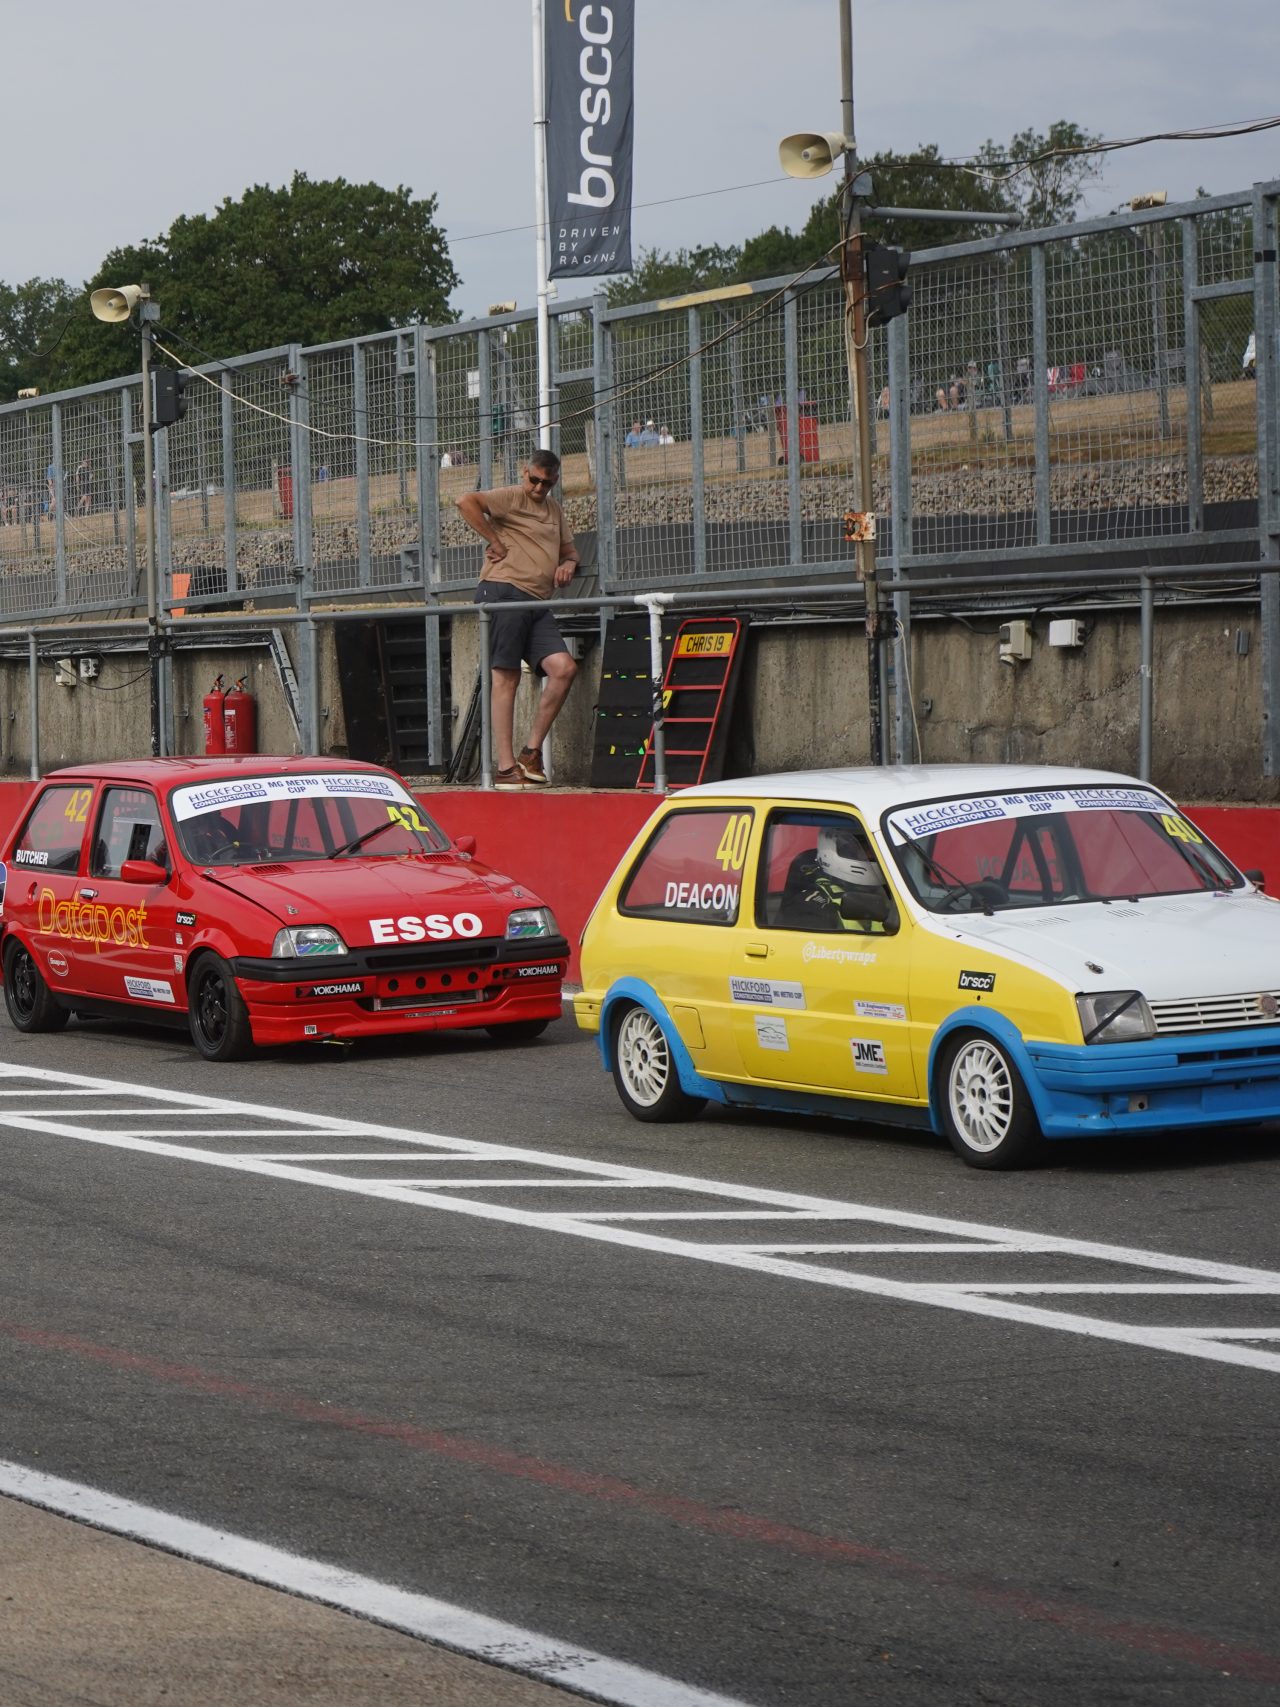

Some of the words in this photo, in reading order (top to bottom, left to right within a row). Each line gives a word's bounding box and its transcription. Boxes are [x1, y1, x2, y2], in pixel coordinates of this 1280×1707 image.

[567, 4, 615, 208] brscc
[559, 225, 620, 238] DRIVEN
[559, 242, 578, 252] BY
[559, 252, 616, 265] RACING
[685, 637, 713, 652] CHRIS
[714, 636, 724, 651] 19
[188, 782, 263, 803] HICKFORD
[285, 778, 319, 787] METRO
[321, 778, 389, 790] HICKFORD
[194, 793, 251, 809] CONSTRUCTION
[64, 789, 93, 822] 42
[904, 799, 997, 827] HICKFORD
[1002, 796, 1022, 806] MG
[1024, 792, 1066, 803] METRO
[1067, 790, 1148, 801] HICKFORD
[386, 806, 430, 832] 42
[914, 811, 986, 834] CONSTRUCTION
[986, 808, 1003, 817] LTD
[1029, 802, 1053, 812] CUP
[1142, 802, 1156, 810] LTD
[1160, 814, 1203, 844] 40
[715, 814, 752, 871] 40
[15, 850, 49, 865] BUTCHER
[664, 882, 738, 910] DEACON
[38, 887, 150, 954] Datapost
[176, 912, 194, 925] brscc
[369, 912, 483, 944] ESSO
[518, 965, 558, 977] YOKOHAMA
[960, 973, 991, 989] brscc
[313, 983, 362, 996] YOKOHAMA
[731, 980, 771, 994] HICKFORD
[780, 991, 794, 999] METRO
